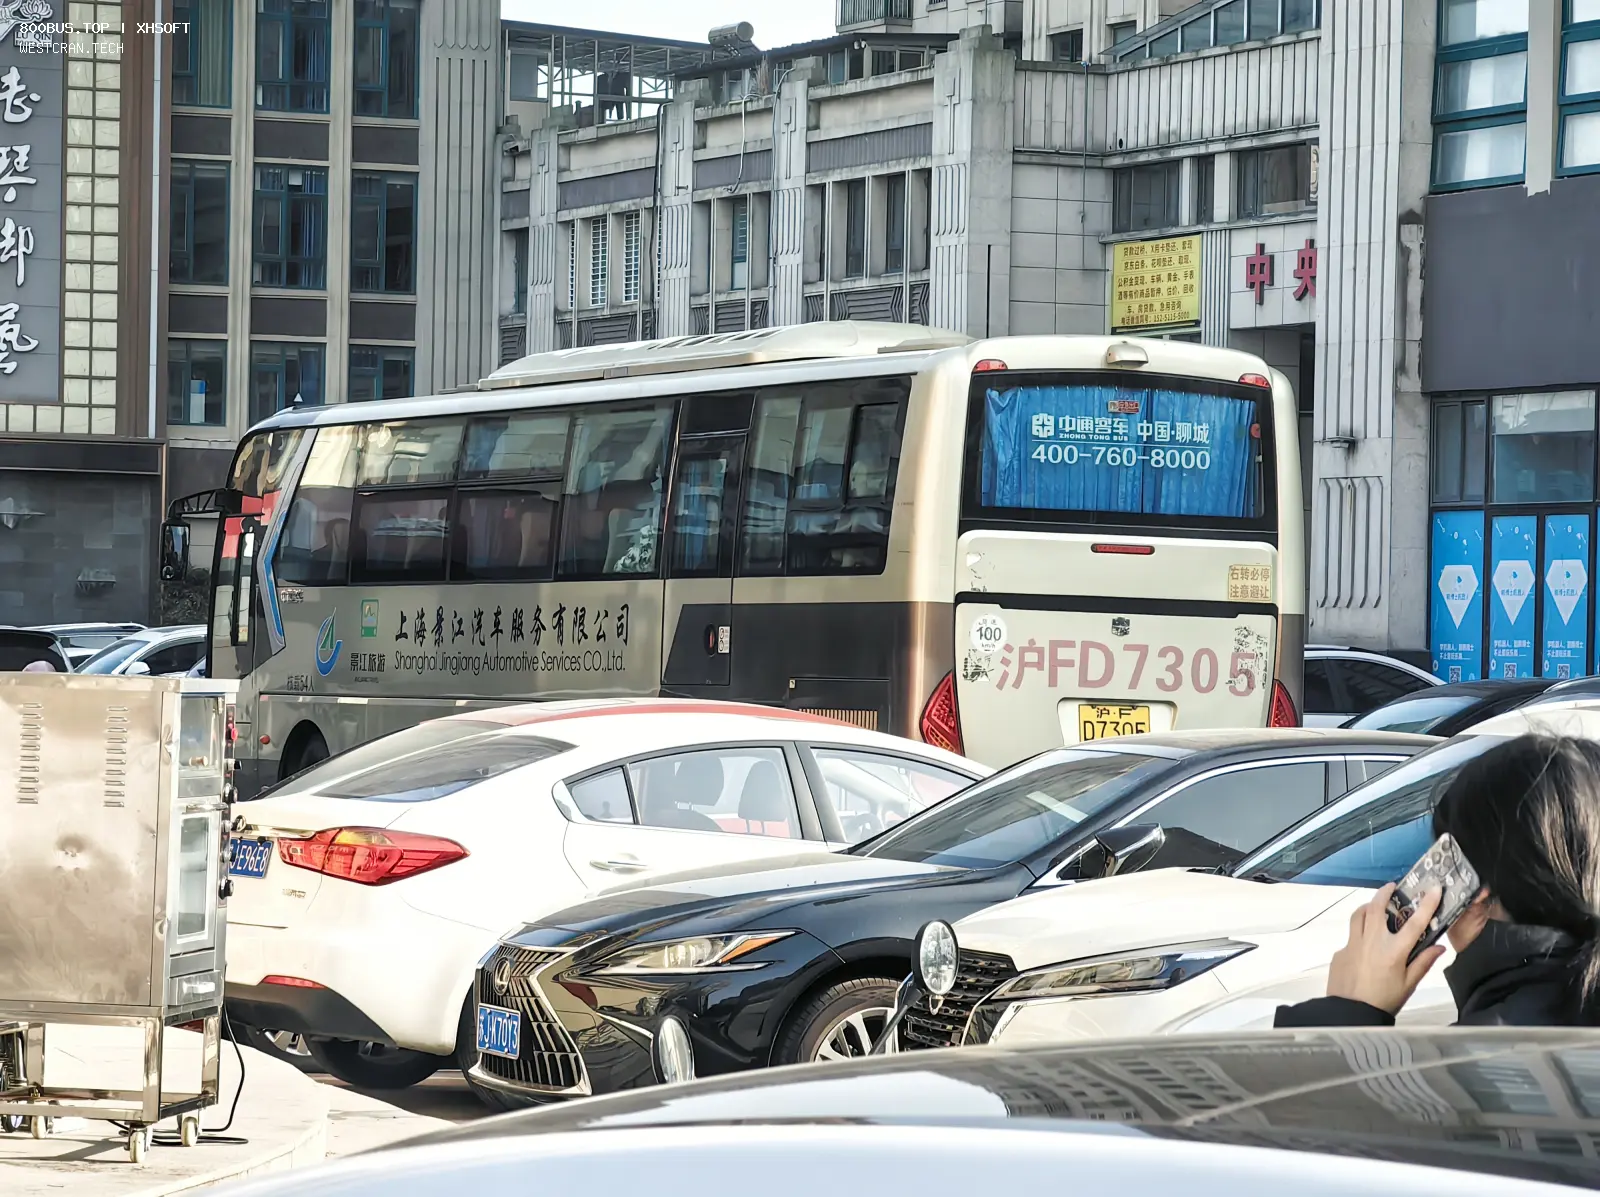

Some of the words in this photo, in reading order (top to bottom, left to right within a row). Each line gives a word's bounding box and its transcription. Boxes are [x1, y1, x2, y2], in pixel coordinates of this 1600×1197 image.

[1246, 239, 1317, 305] 中央
[1058, 415, 1129, 435] 中通客车
[1058, 432, 1087, 440] ZHONG
[1031, 443, 1211, 470] 400-760-8000
[1230, 566, 1270, 582] 右转必停
[1229, 584, 1270, 600] 注意避让
[395, 602, 629, 649] 上海景江汽车服务有限公司
[976, 626, 1002, 642] 100
[350, 652, 386, 672] 景江旅游
[394, 650, 439, 675] Shanghai
[439, 650, 481, 676] Jingjiang
[482, 650, 539, 672] Automotive
[540, 650, 582, 672] Services
[996, 638, 1256, 697] 沪FD7305
[1083, 720, 1146, 741] D7305
